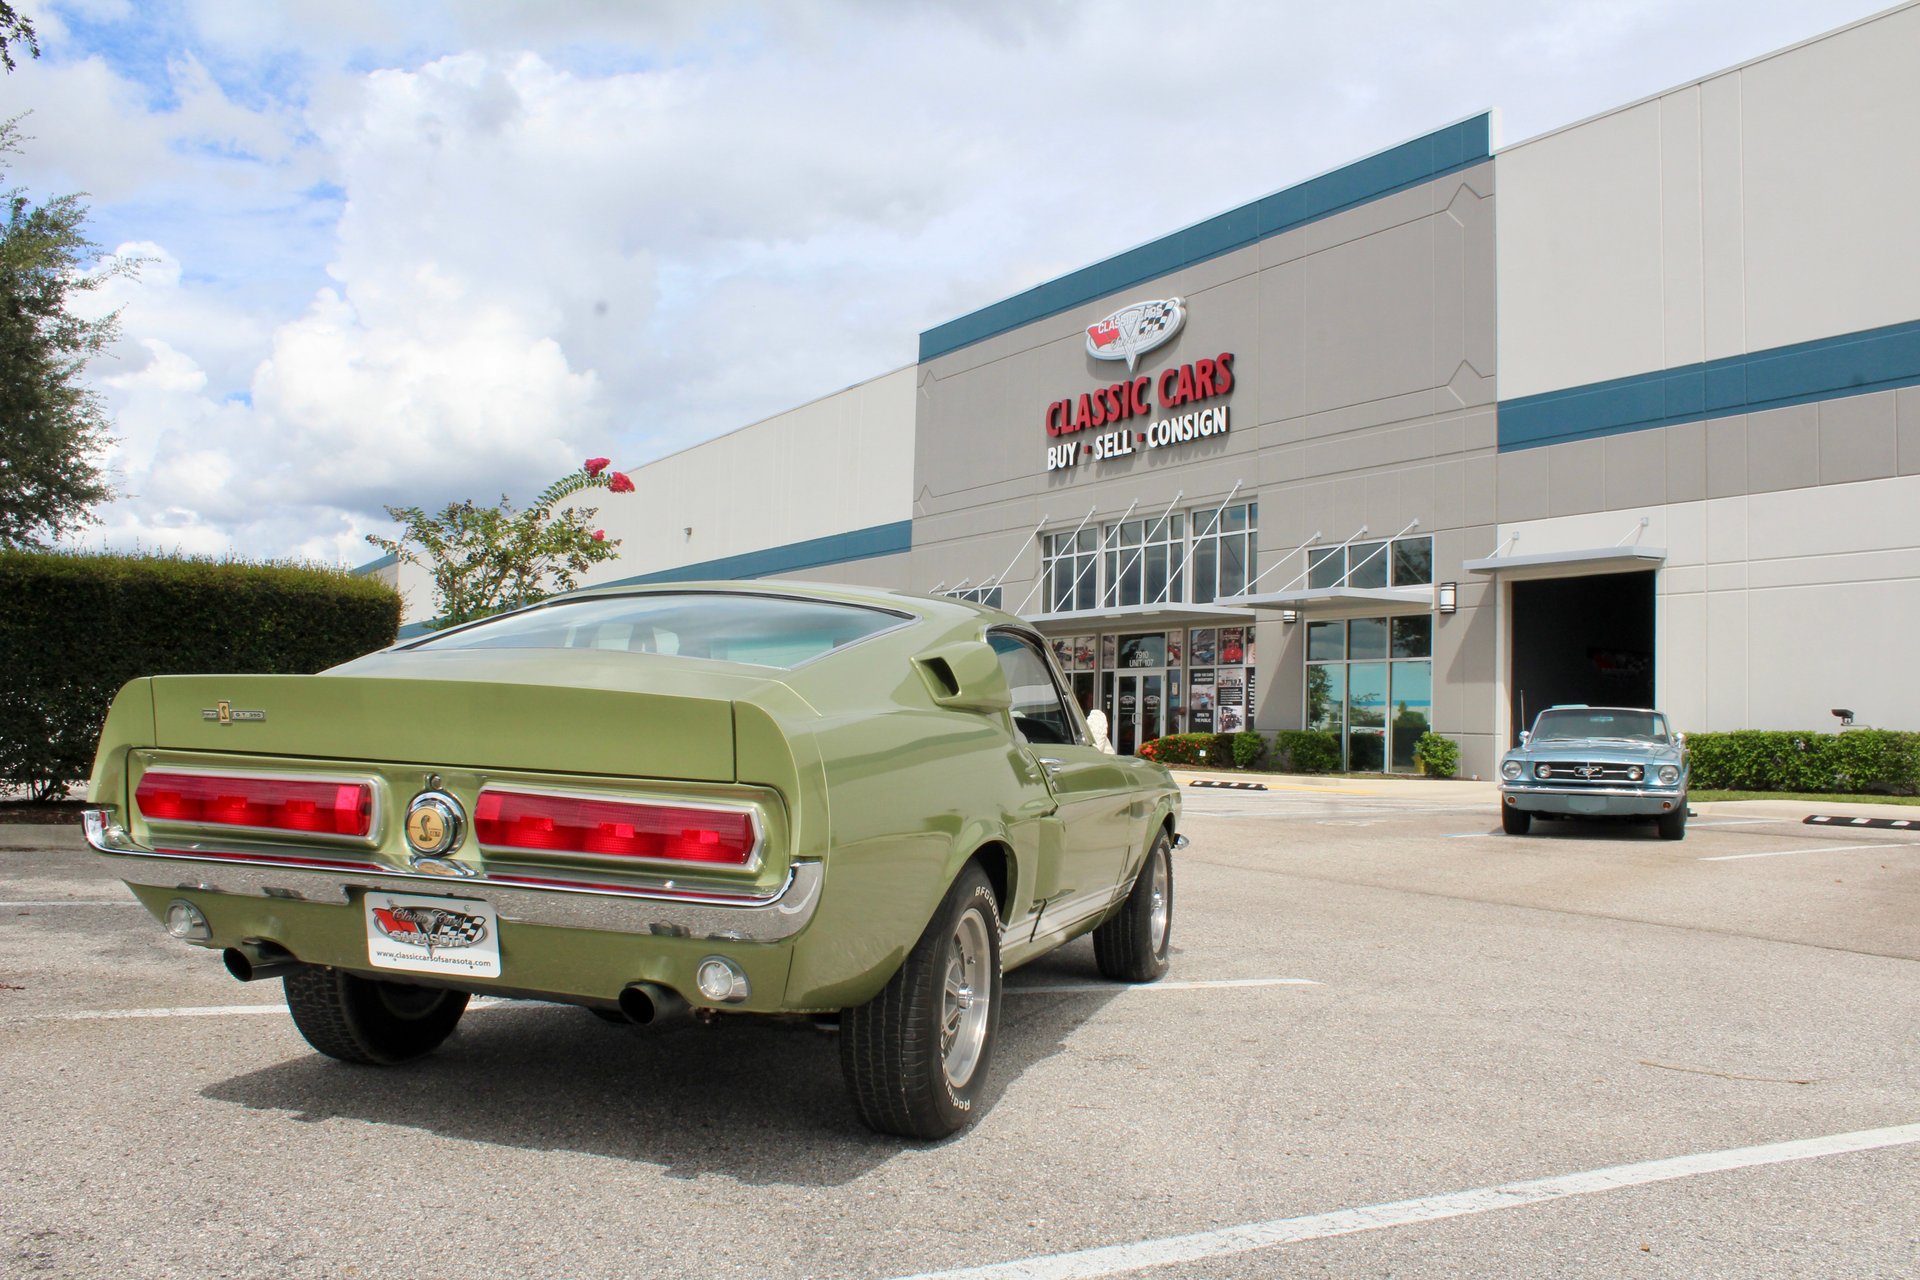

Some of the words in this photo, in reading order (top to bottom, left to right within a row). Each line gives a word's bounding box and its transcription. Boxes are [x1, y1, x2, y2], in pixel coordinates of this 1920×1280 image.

[1046, 376, 1150, 438] CLASSIC
[1157, 352, 1234, 408] CARS
[1047, 441, 1078, 471] BUY
[1095, 429, 1133, 460] SELL
[1148, 405, 1228, 448] CONSIGN
[1129, 659, 1142, 667] UNIT
[390, 931, 469, 948] SARASOTA
[376, 950, 491, 967] www.classiccarsofsarasota.com
